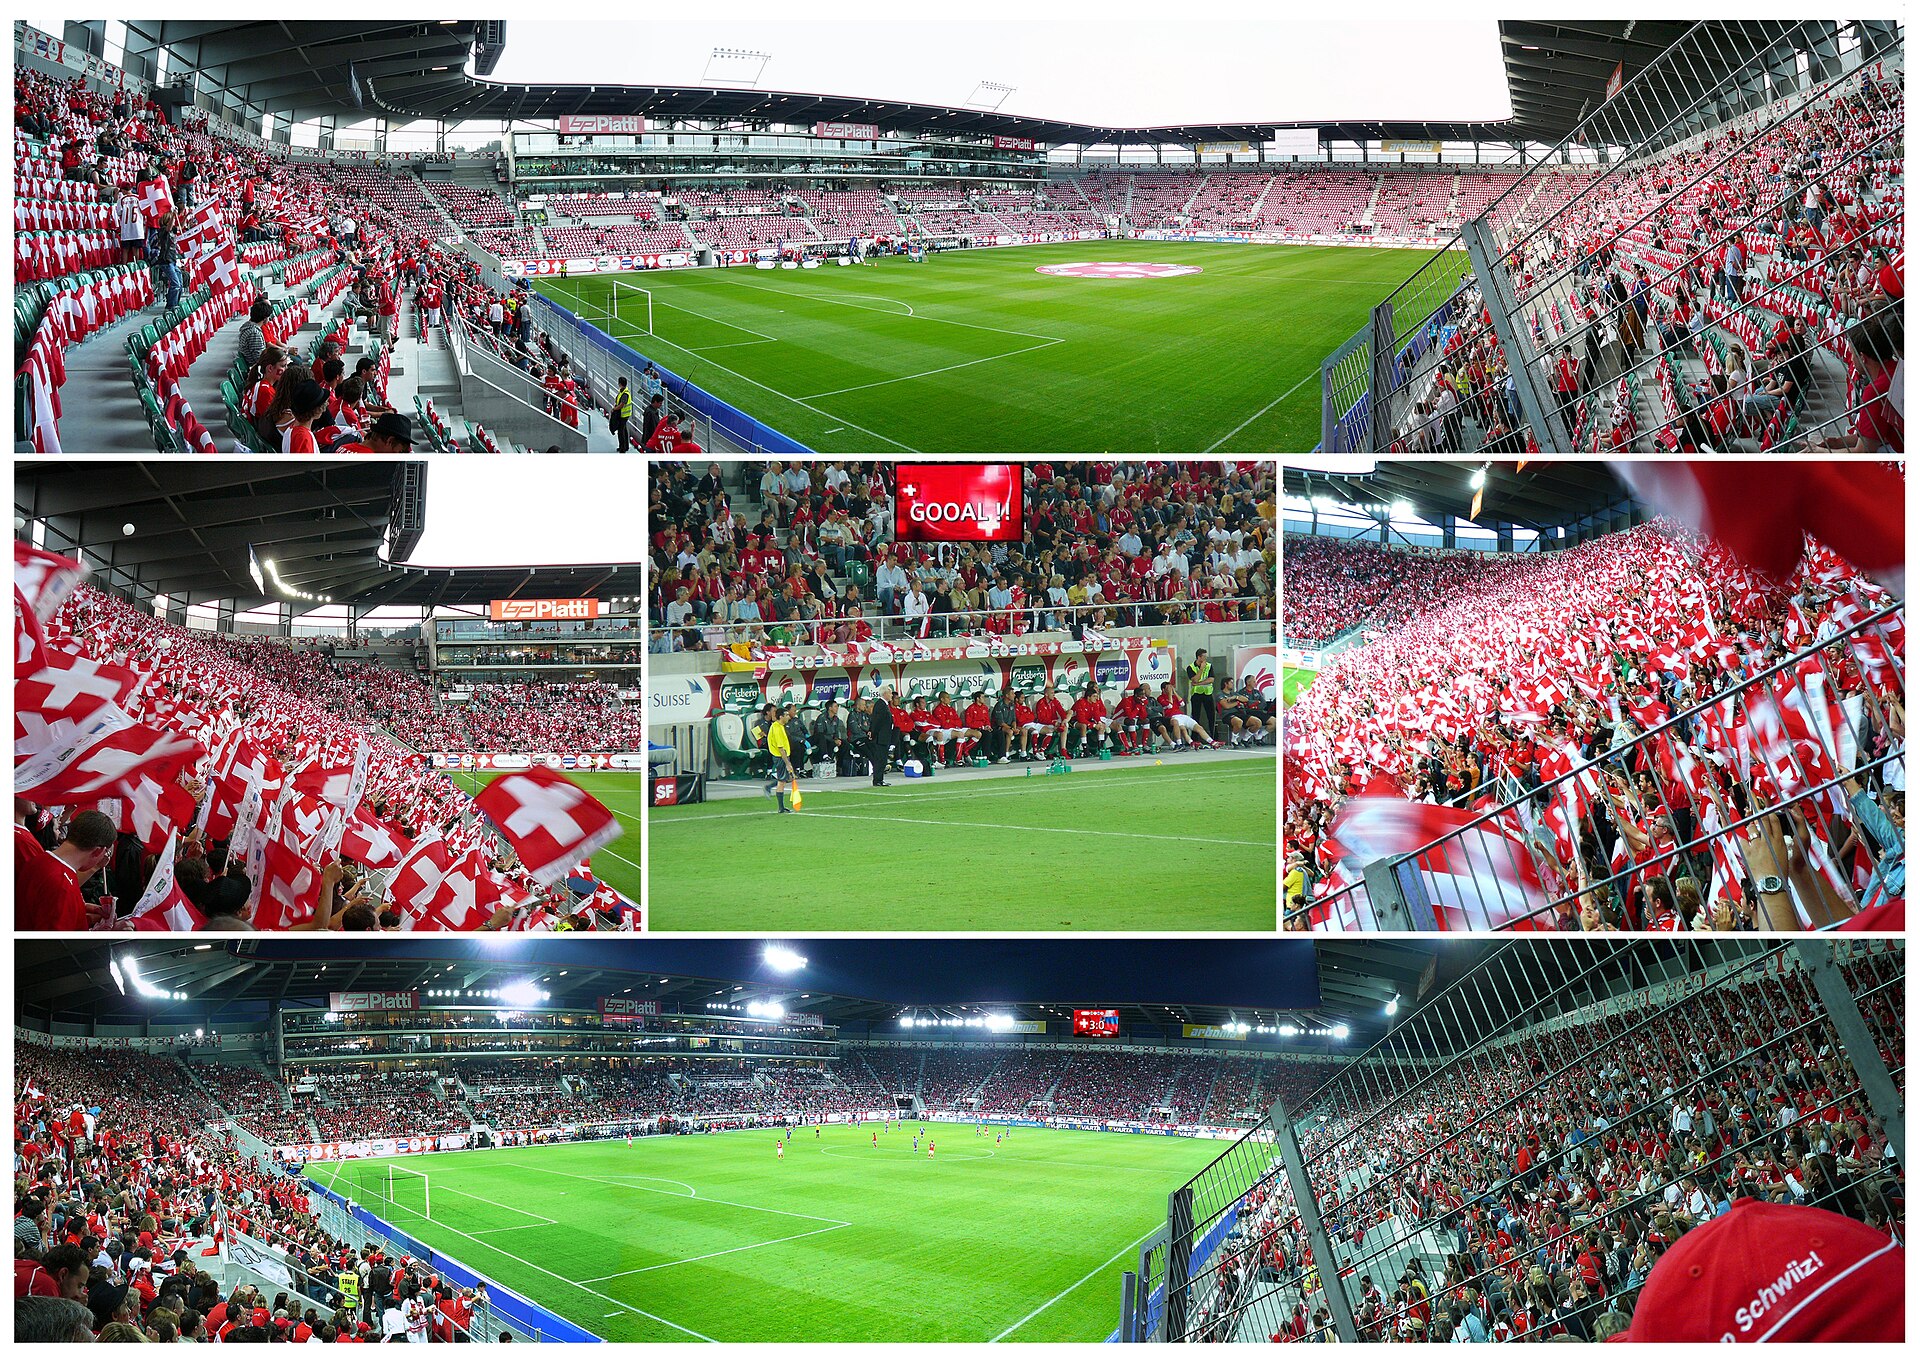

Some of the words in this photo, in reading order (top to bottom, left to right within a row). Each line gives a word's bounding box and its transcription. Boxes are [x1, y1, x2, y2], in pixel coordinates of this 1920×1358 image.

[597, 117, 638, 132] Piatti
[845, 124, 873, 139] Piatti
[1012, 138, 1032, 150] Piatti
[1389, 140, 1434, 152] arbonia
[124, 206, 138, 225] 16
[910, 502, 989, 522] GOOAL
[537, 600, 589, 618] Piatti
[1140, 672, 1169, 681] swisscom
[653, 693, 691, 707] SUISSE
[656, 784, 674, 799] SF
[369, 993, 412, 1009] Piatti
[626, 1000, 656, 1015] Piatti
[799, 1013, 820, 1026] Piatti
[1089, 1020, 1105, 1030] 3:0
[1179, 1131, 1197, 1139] VART
